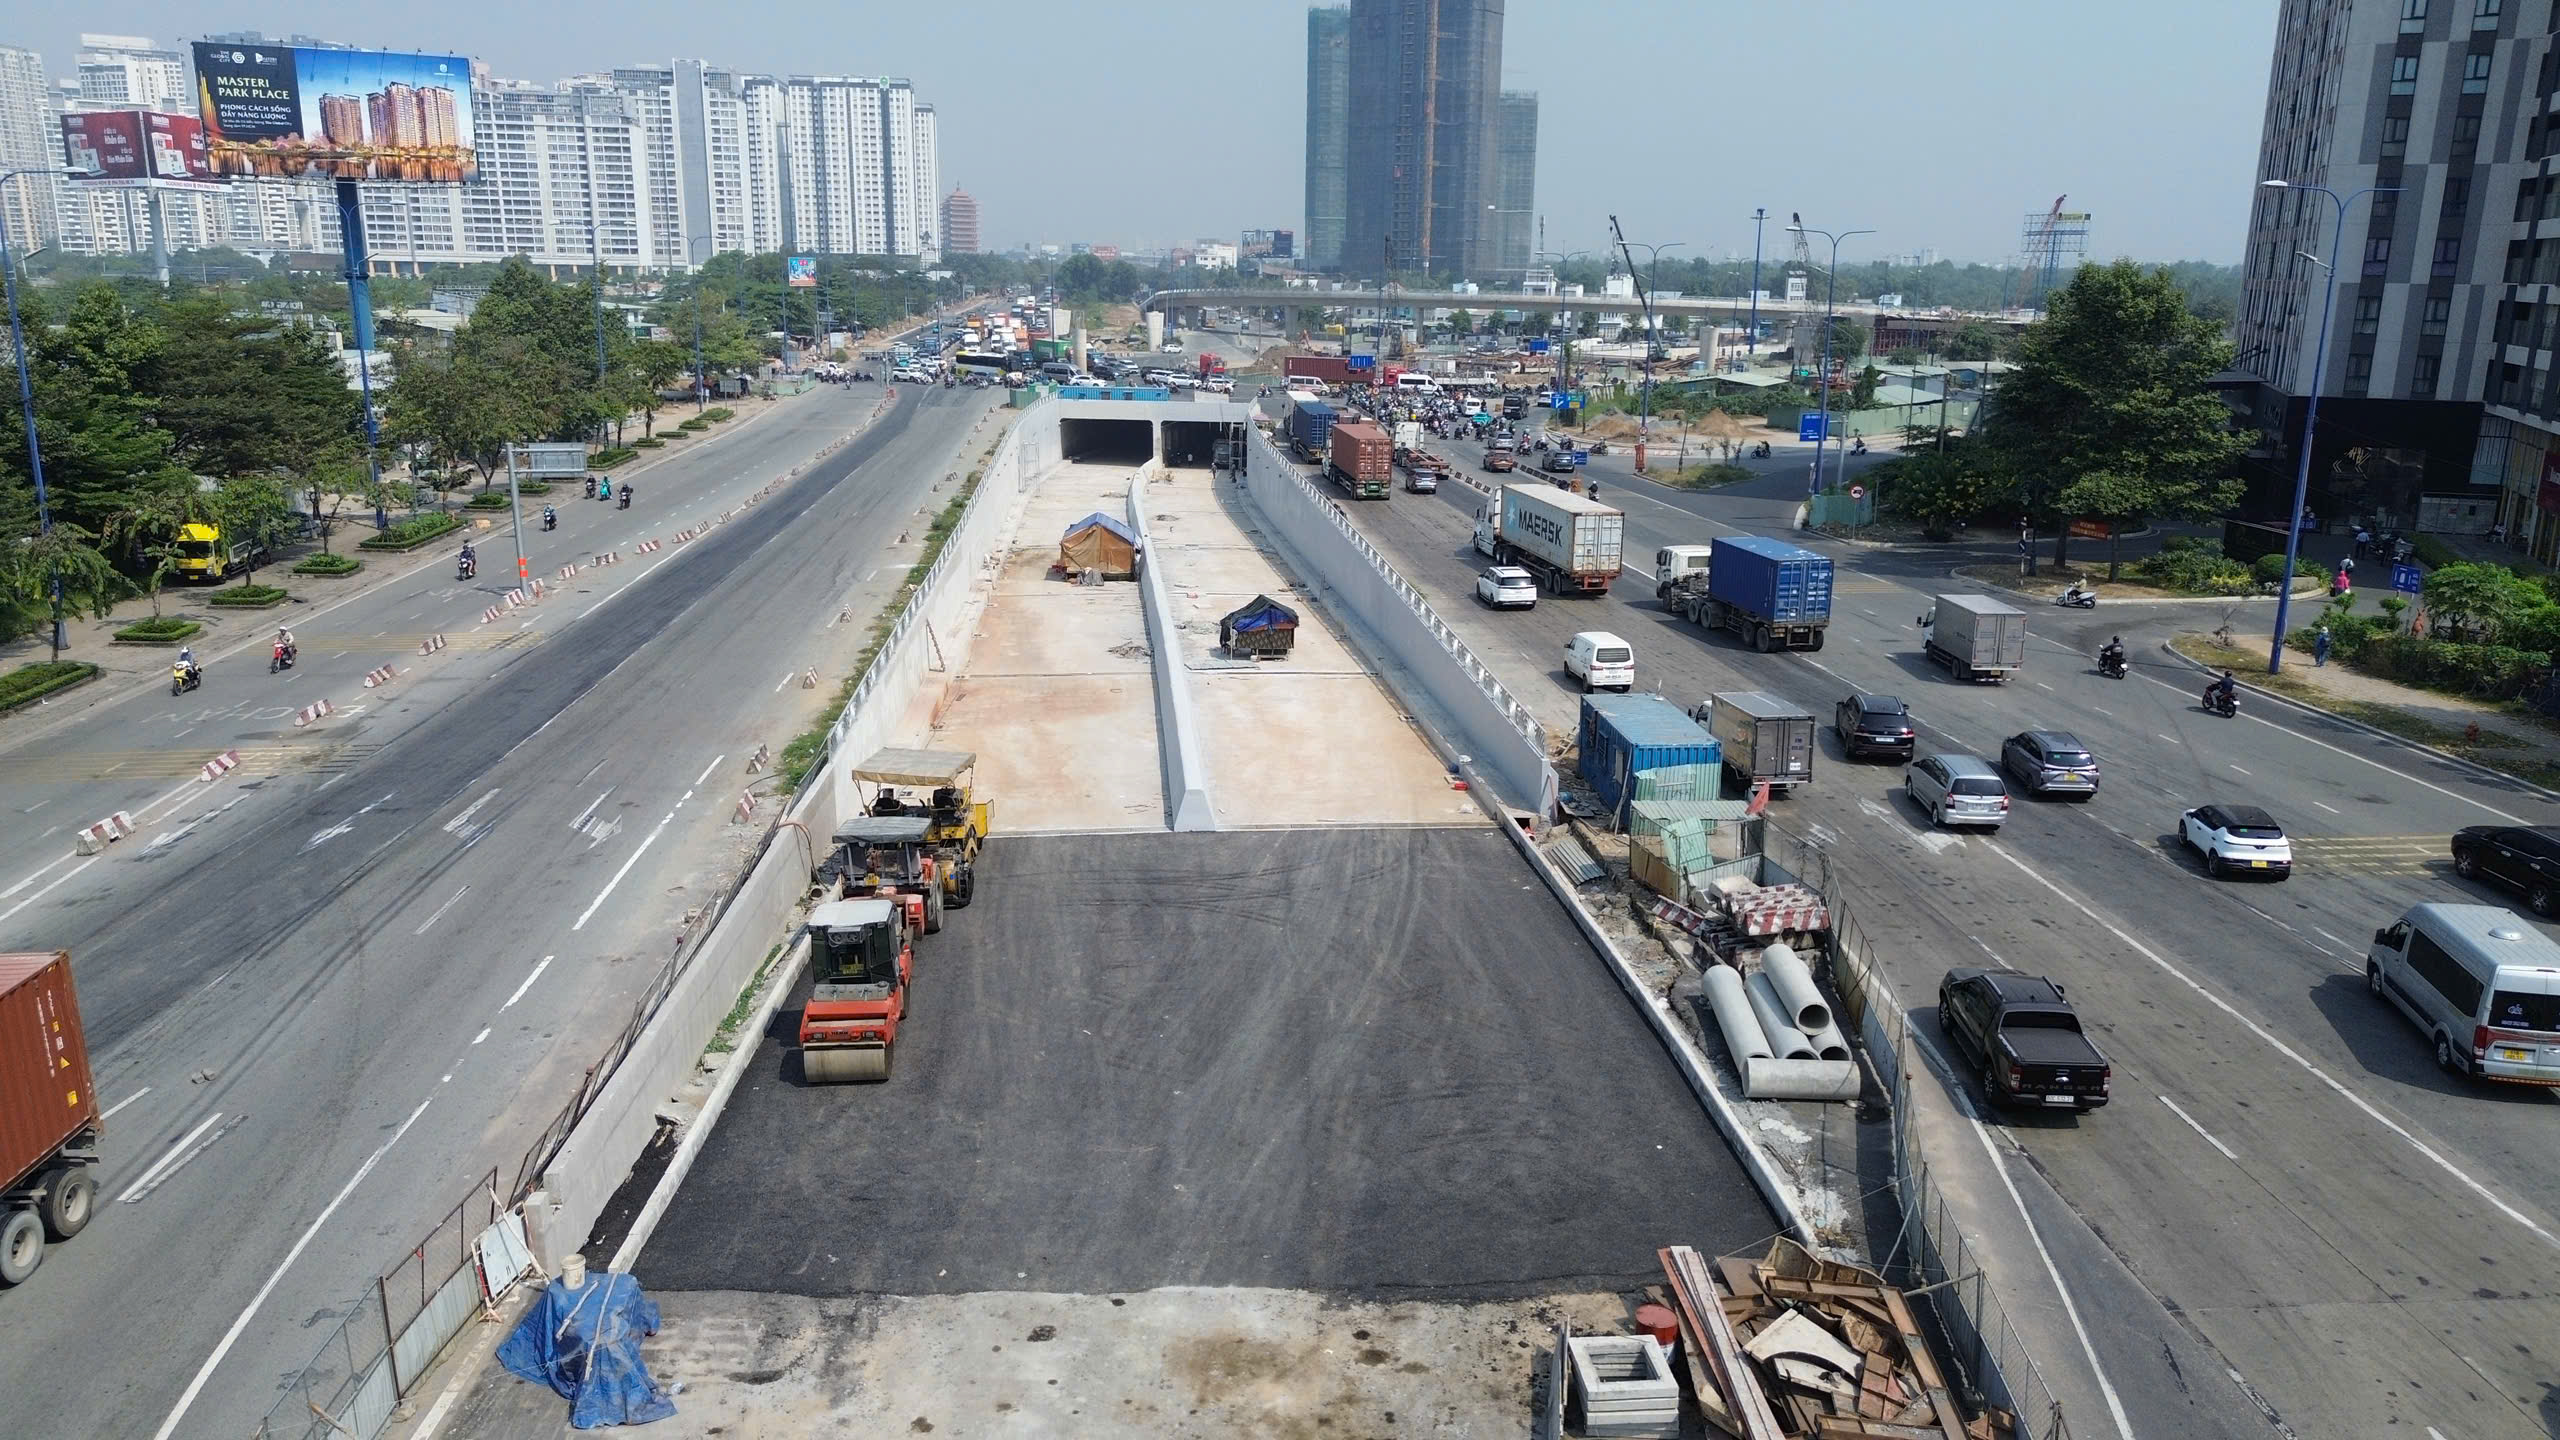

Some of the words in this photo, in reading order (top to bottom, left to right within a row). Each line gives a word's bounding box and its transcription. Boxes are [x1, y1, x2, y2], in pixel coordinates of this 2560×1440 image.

[217, 76, 270, 88] MASTERI
[218, 87, 249, 98] PARK
[252, 89, 290, 100] PLACE
[220, 103, 247, 111] PHONG
[248, 103, 269, 112] CÁCH
[270, 103, 291, 113] SỐNG
[1518, 508, 1563, 548] MAERSK
